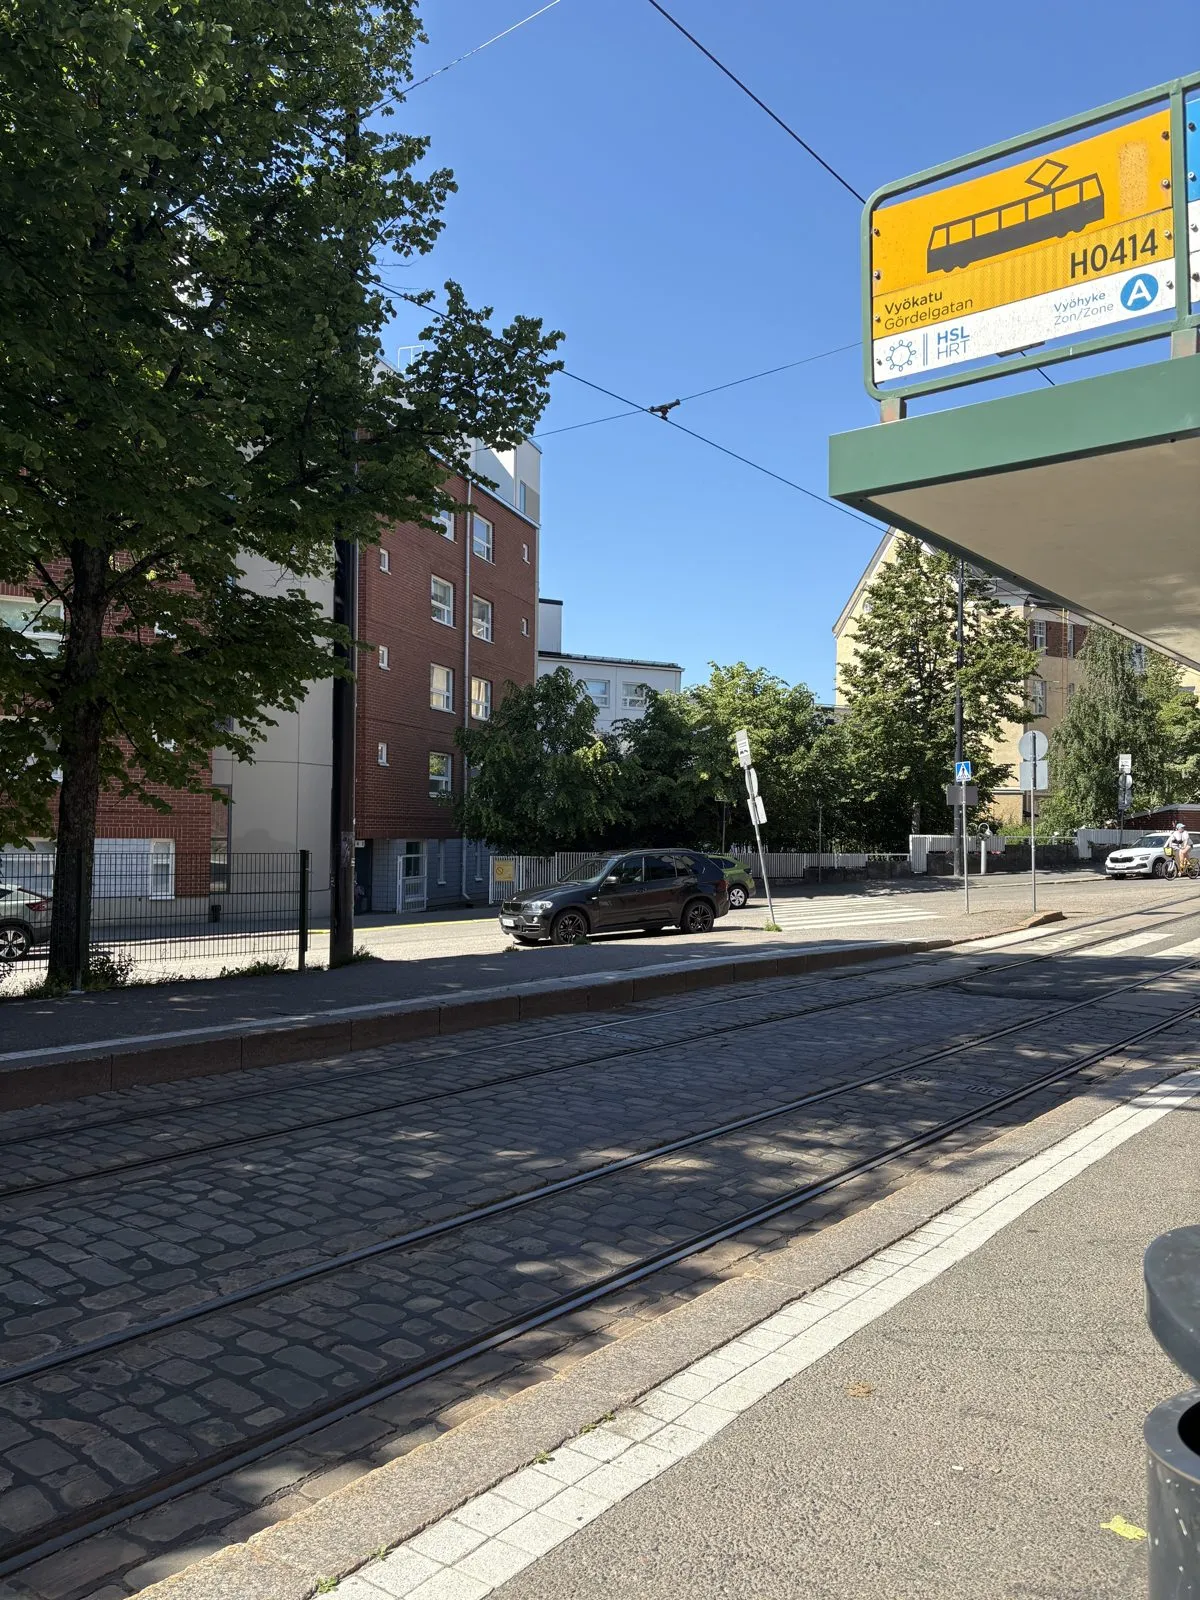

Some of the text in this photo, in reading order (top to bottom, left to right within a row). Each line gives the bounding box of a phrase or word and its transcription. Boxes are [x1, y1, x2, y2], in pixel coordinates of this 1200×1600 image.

[1071, 228, 1158, 279] H0414
[885, 291, 942, 315] Vyökatu
[1054, 292, 1106, 313] Vyöhyke
[1126, 278, 1152, 306] A
[884, 299, 973, 330] Gördelgatan
[1054, 303, 1114, 326] Zon/Zone
[937, 326, 970, 345] HSL
[937, 339, 970, 360] HRT
